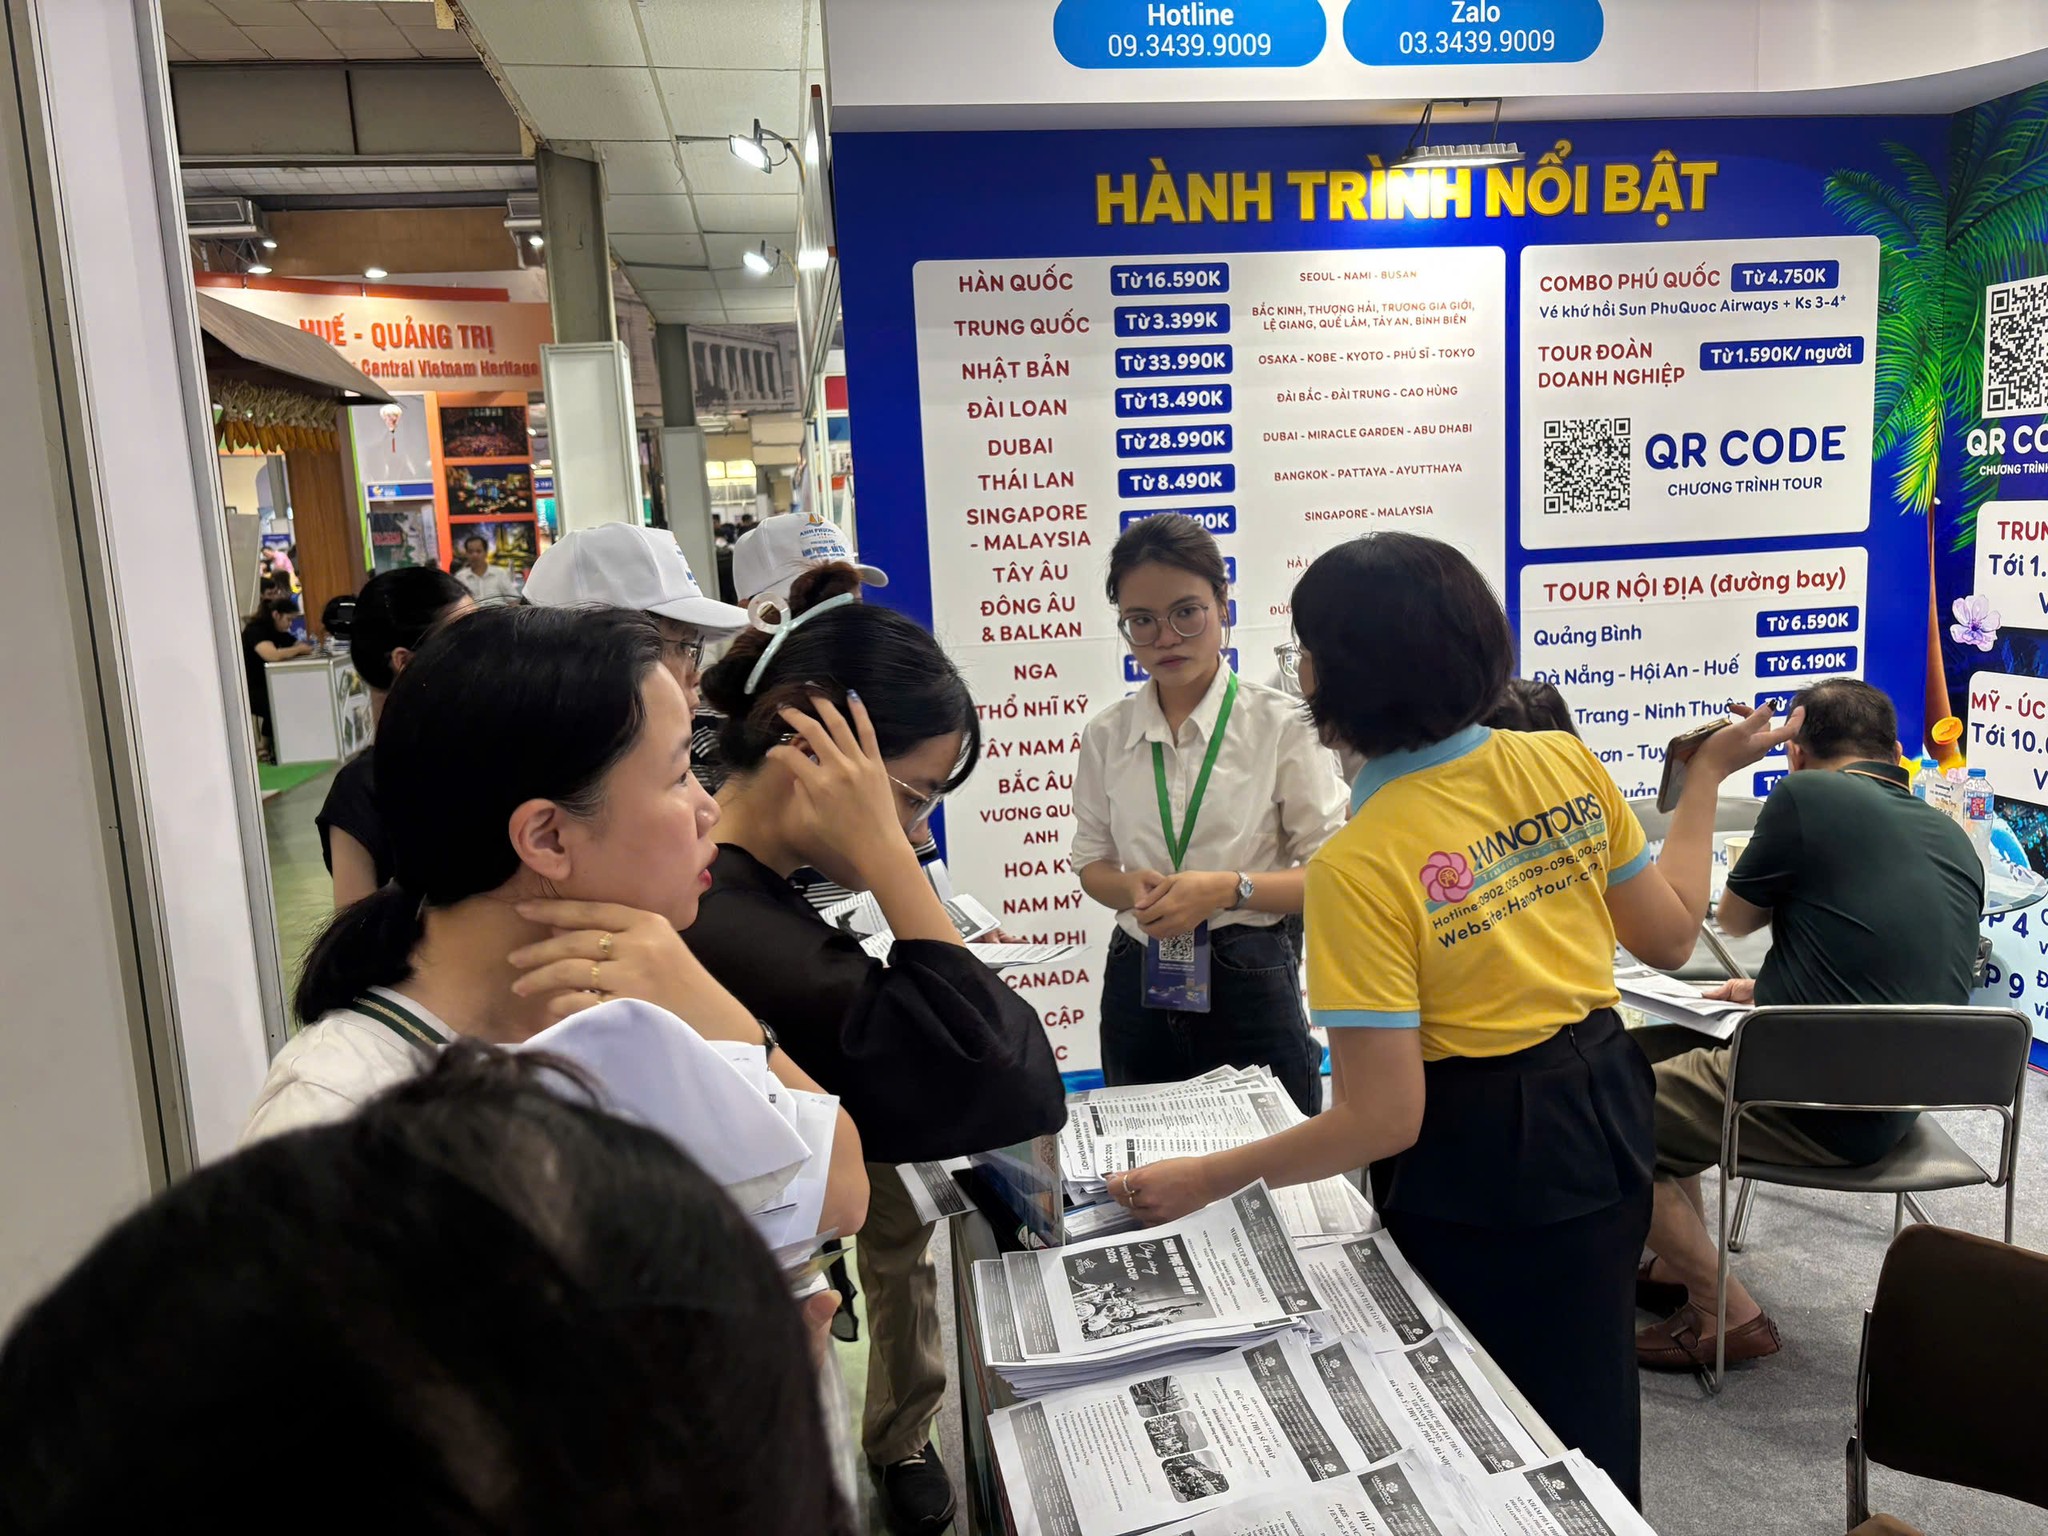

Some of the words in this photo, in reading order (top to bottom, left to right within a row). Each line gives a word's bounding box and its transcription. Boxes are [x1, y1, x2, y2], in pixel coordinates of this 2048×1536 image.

[1147, 3, 1234, 27] Hotline
[1451, 1, 1501, 23] Zalo
[1108, 33, 1272, 58] 09.3439.9009
[1399, 29, 1555, 54] 03.3439.9009
[1096, 156, 1267, 224] HÀNH
[1287, 153, 1471, 222] TRÌNH
[1485, 139, 1590, 217] NỔI
[1602, 149, 1719, 227] BẬT
[959, 270, 1003, 293] HÀN
[1010, 264, 1073, 291] QUỐC
[1117, 272, 1142, 289] Từ
[1145, 270, 1221, 288] 16.590K
[1299, 272, 1335, 282] SEOUL
[1344, 271, 1372, 281] NAMI
[1381, 270, 1418, 280] BUSAN
[1540, 274, 1613, 292] COMBO
[1617, 267, 1658, 289] PHÚ
[1663, 261, 1721, 288] QUỐC
[1742, 268, 1766, 286] Từ
[1768, 268, 1826, 285] 4.750K
[1252, 302, 1275, 316] BẮC
[1277, 306, 1306, 316] KINH,
[1308, 304, 1355, 315] THƯỢNG
[1357, 300, 1379, 313] HẢI,
[1382, 303, 1427, 313] TRƯƠNG
[1429, 301, 1447, 311] GIA
[1539, 306, 1558, 319] Vé
[1562, 302, 1590, 318] khứ
[1592, 300, 1616, 317] hồi
[1619, 302, 1647, 316] Sun
[1650, 300, 1717, 315] PhuQuoc
[1720, 298, 1778, 314] Airways
[1795, 296, 1812, 310] Ks
[954, 319, 1024, 337] TRUNG
[1030, 309, 1090, 335] QUỐC
[1125, 313, 1150, 330] Từ
[1153, 311, 1218, 329] 3.399K
[1263, 317, 1277, 332] LỆ
[1279, 320, 1316, 331] GIANG,
[1319, 315, 1342, 329] QUẾ
[1443, 312, 1467, 324] BIÊN
[371, 315, 453, 351] QUẢNG
[457, 324, 494, 354] TRỊ
[1258, 354, 1298, 364] OSAKA
[1307, 353, 1337, 363] KOBE
[1346, 351, 1384, 361] KYOTO
[1393, 347, 1417, 359] PHÚ
[1438, 348, 1476, 358] TOKYO
[1538, 345, 1592, 362] TOUR
[1596, 337, 1653, 360] ĐOÀN
[1711, 349, 1734, 365] Từ
[1736, 346, 1800, 363] 1.590K/
[1804, 344, 1853, 363] người
[362, 359, 414, 378] Central
[418, 360, 477, 378] Vietnam
[480, 361, 539, 378] Heritage
[962, 357, 1021, 383] NHẬT
[1027, 353, 1070, 377] BẢN
[1120, 354, 1146, 372] Từ
[1148, 352, 1226, 370] 33.990K
[1538, 371, 1608, 388] DOANH
[1613, 362, 1685, 388] NGHIỆP
[1121, 393, 1147, 410] Từ
[1149, 390, 1223, 409] 13.490K
[1277, 389, 1296, 402] ĐÀI
[1298, 386, 1322, 402] BẮC
[1331, 387, 1350, 401] ĐÀI
[1352, 389, 1391, 400] TRUNG
[1400, 388, 1424, 398] CAO
[1426, 383, 1458, 397] HÙNG
[967, 396, 1004, 419] ĐÀI
[1010, 399, 1067, 418] LOAN
[1121, 433, 1147, 451] Từ
[1149, 430, 1225, 450] 28.990K
[1263, 432, 1298, 442] DUBAI
[1307, 429, 1357, 440] MIRACLE
[1359, 427, 1405, 438] GARDEN
[1413, 425, 1436, 436] ABU
[1438, 424, 1473, 435] DHABI
[1967, 428, 2006, 457] QR
[988, 438, 1053, 457] DUBAI
[1645, 432, 1707, 470] QR
[1720, 425, 1847, 466] CODE
[978, 468, 1028, 491] THÁI
[1034, 471, 1074, 489] LAN
[1274, 470, 1328, 482] BANGKOK
[1337, 467, 1387, 478] PATTAYA
[1396, 463, 1463, 475] AYUTTHAYA
[1980, 463, 2021, 476] CHƯƠNG
[1129, 472, 1155, 491] Từ
[1157, 471, 1223, 490] 8.490K
[1667, 480, 1733, 497] CHƯƠNG
[1734, 475, 1779, 493] TRÌNH
[1782, 476, 1823, 492] TOUR
[966, 504, 1087, 525] SINGAPORE
[1304, 508, 1368, 521] SINGAPORE
[1377, 505, 1434, 518] MALAYSIA
[984, 530, 1091, 551] MALAYSIA
[992, 561, 1034, 583] TÂY
[1039, 560, 1068, 581] ÂU
[1988, 553, 2024, 576] Tới
[1543, 580, 1610, 603] TOUR
[1616, 572, 1657, 602] NỘI
[1663, 575, 1703, 597] ĐỊA
[1710, 570, 1789, 597] (đường
[1797, 566, 1847, 591] bay)
[980, 594, 1041, 617] ĐÔNG
[1047, 592, 1075, 613] ÂU
[982, 627, 995, 642] &
[1000, 622, 1082, 641] BALKAN
[1766, 614, 1789, 632] Từ
[1791, 612, 1849, 631] 6.590K
[1534, 626, 1597, 648] Quảng
[1601, 624, 1642, 642] Bình
[1014, 663, 1058, 680] NGA
[1564, 661, 1614, 686] Nẵng
[1630, 663, 1662, 685] Hội
[1664, 662, 1688, 677] An
[1704, 653, 1740, 675] Huế
[1767, 655, 1790, 671] Từ
[1792, 653, 1846, 670] 6.190K
[975, 693, 1018, 719] THỔ
[1024, 695, 1059, 717] NHĨ
[1064, 694, 1089, 715] KỸ
[1575, 707, 1629, 728] Trang
[1644, 701, 1686, 719] Ninh
[1971, 689, 2000, 712] MỸ
[2018, 692, 2046, 720] ÚC
[1971, 722, 2005, 747] Tới
[1019, 739, 1064, 756] NAM
[999, 769, 1039, 794] BẮC
[1045, 770, 1073, 791] ÂU
[980, 806, 1041, 823] VƯƠNG
[1023, 830, 1059, 845] ANH
[1468, 793, 1602, 871] HANOTOURS
[1004, 860, 1048, 878] HOA
[1003, 896, 1048, 914] NAM
[1054, 890, 1083, 910] MỸ
[2012, 912, 2029, 938] 4
[1005, 968, 1089, 991] CANADA
[2009, 973, 2025, 999] 9
[1044, 1006, 1084, 1029] CẬP
[1104, 1247, 1119, 1265] 2026
[1119, 1245, 1135, 1267] WORLD
[1125, 1262, 1140, 1281] CUP
[1355, 1510, 1376, 1532] PHÁP
